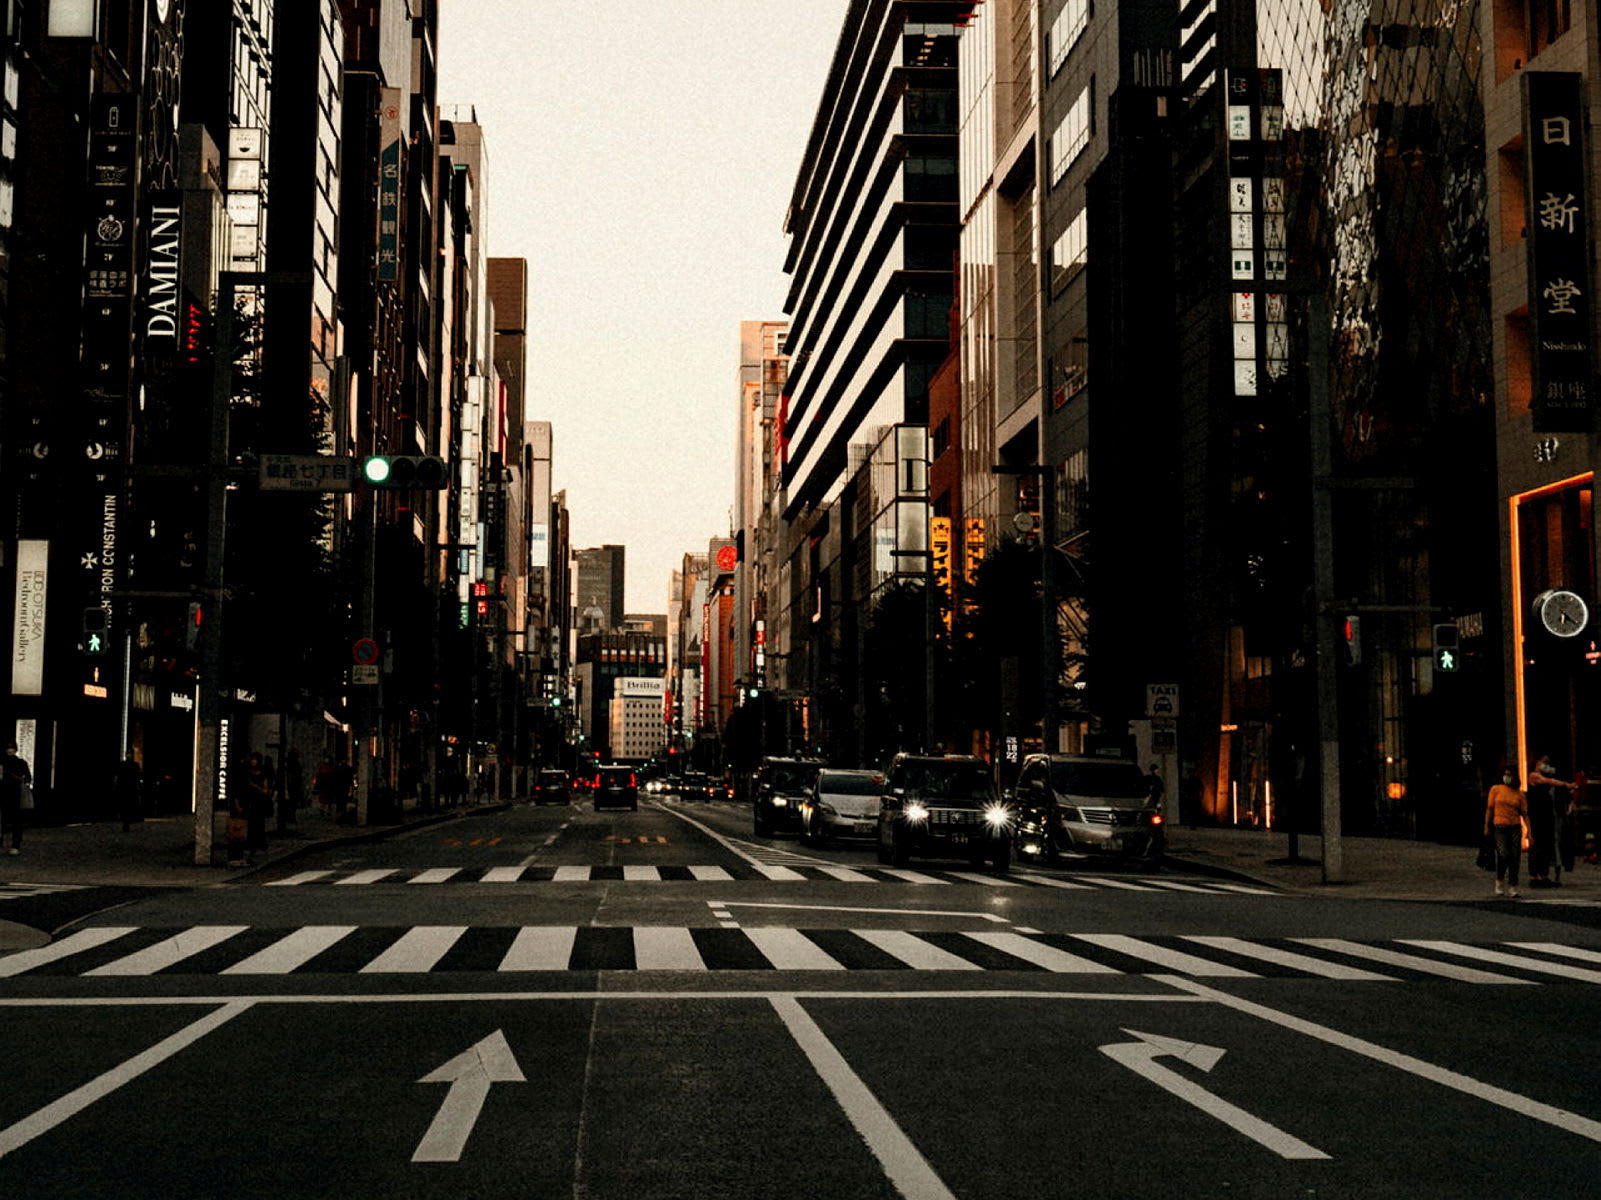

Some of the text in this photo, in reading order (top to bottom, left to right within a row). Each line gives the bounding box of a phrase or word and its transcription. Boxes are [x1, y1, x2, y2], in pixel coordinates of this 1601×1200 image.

[1539, 116, 1582, 315] 日新堂
[147, 204, 180, 338] DAMIANI
[102, 495, 117, 566] CONSTANTIN
[1151, 687, 1176, 695] TAXI
